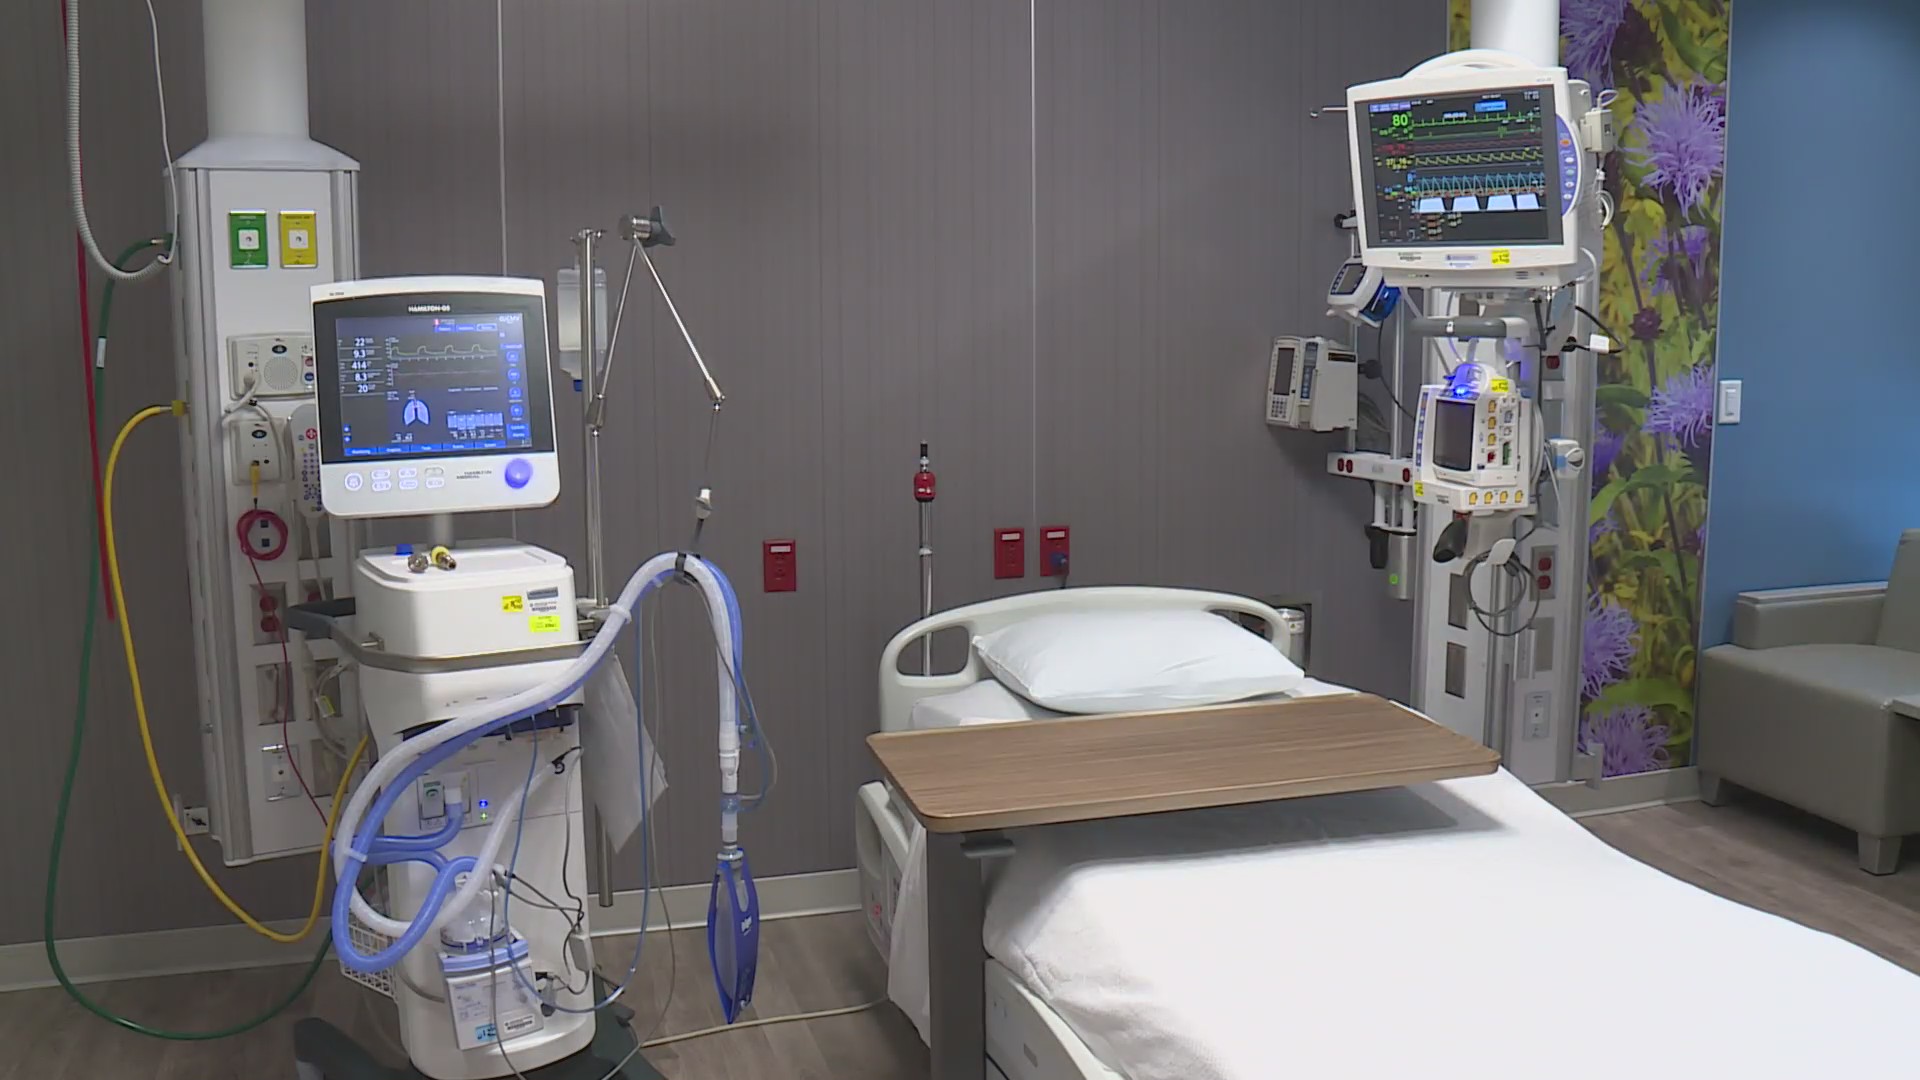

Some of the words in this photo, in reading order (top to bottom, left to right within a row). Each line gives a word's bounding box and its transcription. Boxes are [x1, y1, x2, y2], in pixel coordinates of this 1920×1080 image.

[1392, 114, 1408, 126] 80
[355, 337, 365, 346] 22
[353, 349, 365, 358] 9.3
[351, 361, 367, 369] 414
[357, 384, 368, 393] 20
